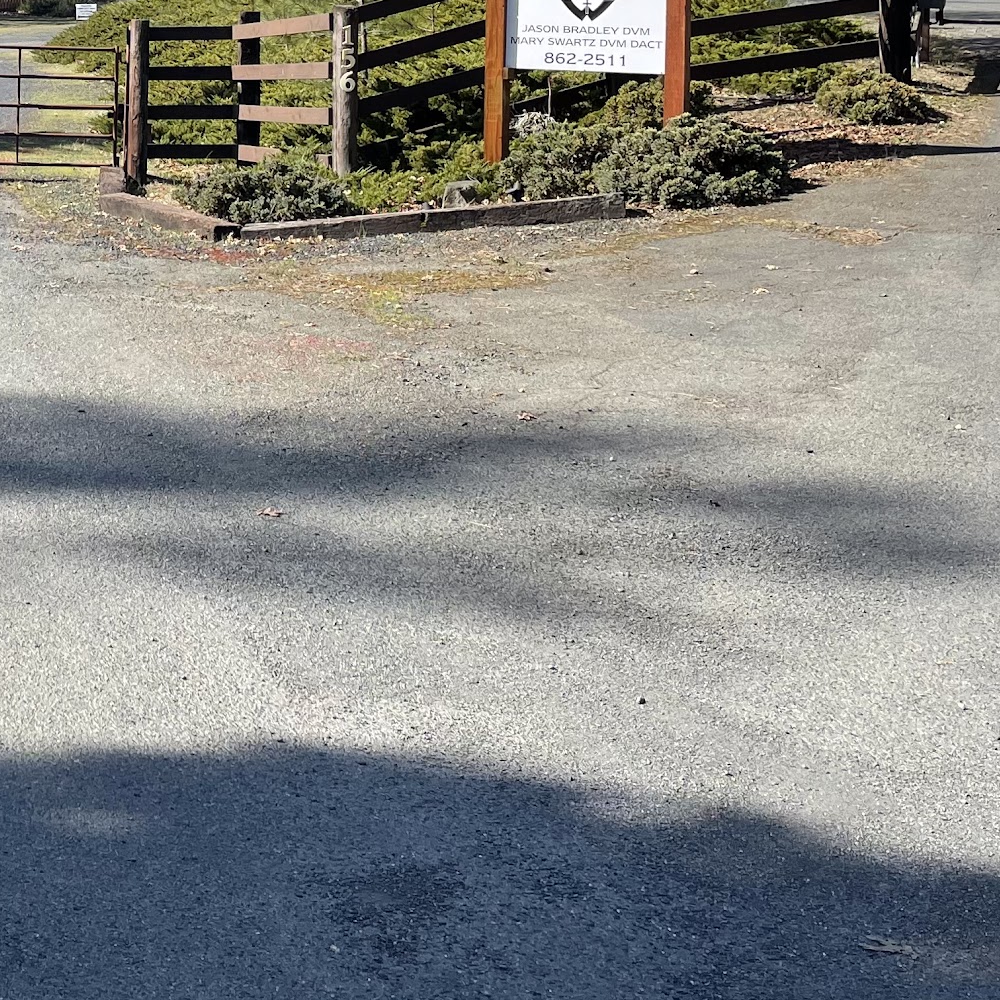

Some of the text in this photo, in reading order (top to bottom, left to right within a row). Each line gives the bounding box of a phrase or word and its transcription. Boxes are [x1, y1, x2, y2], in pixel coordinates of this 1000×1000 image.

[522, 24, 650, 36] JASON BRADLEY DVM
[510, 36, 663, 49] MARY SWARTZ DVM DACT
[340, 24, 356, 93] 156
[544, 52, 626, 66] 862-2511
